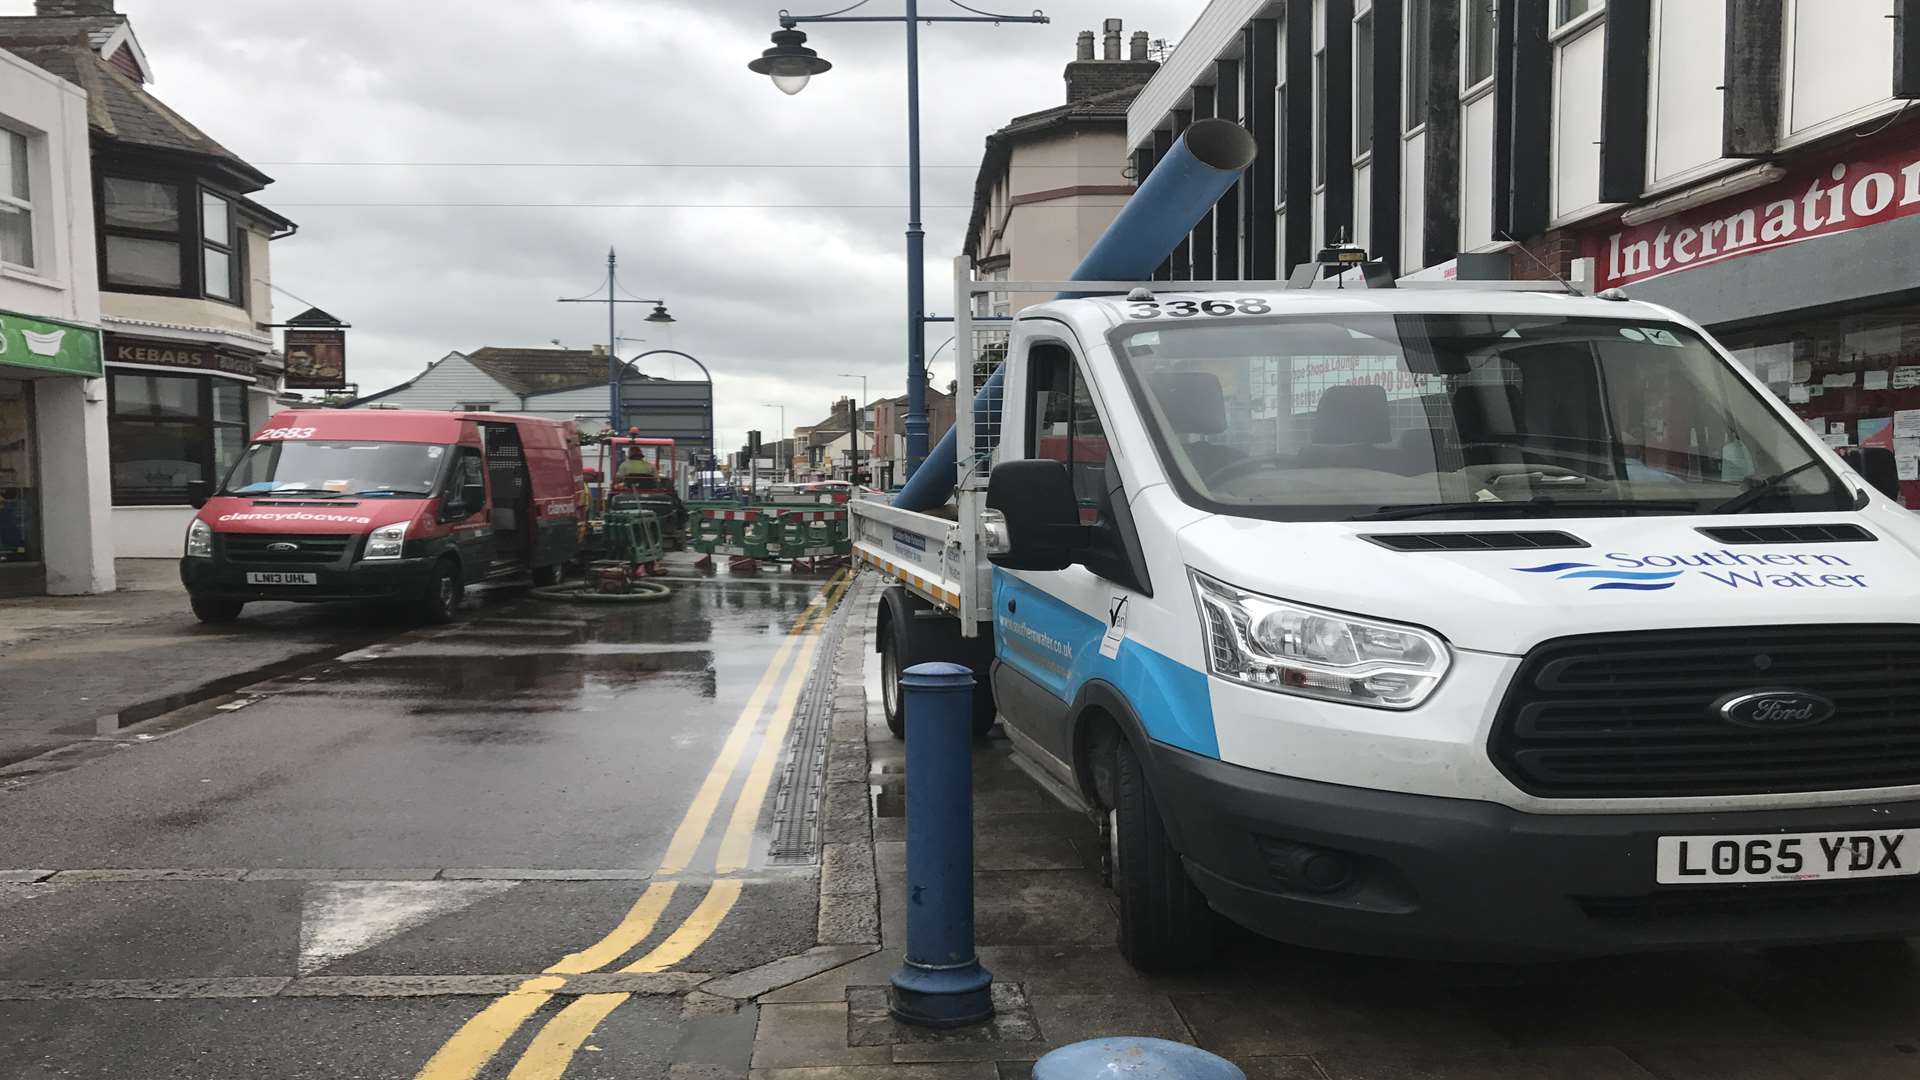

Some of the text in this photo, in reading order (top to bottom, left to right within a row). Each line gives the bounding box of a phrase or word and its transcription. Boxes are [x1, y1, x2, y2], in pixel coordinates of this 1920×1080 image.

[1129, 297, 1272, 320] 3368
[118, 346, 201, 366] KEBABS
[255, 427, 317, 440] 2683
[218, 512, 372, 524] clancydocwra
[1605, 549, 1852, 569] Southern
[254, 573, 309, 584] LN13 UHL
[1699, 570, 1869, 589] Water
[1752, 699, 1813, 720] Ford
[1678, 834, 1905, 876] LO65 YDX
